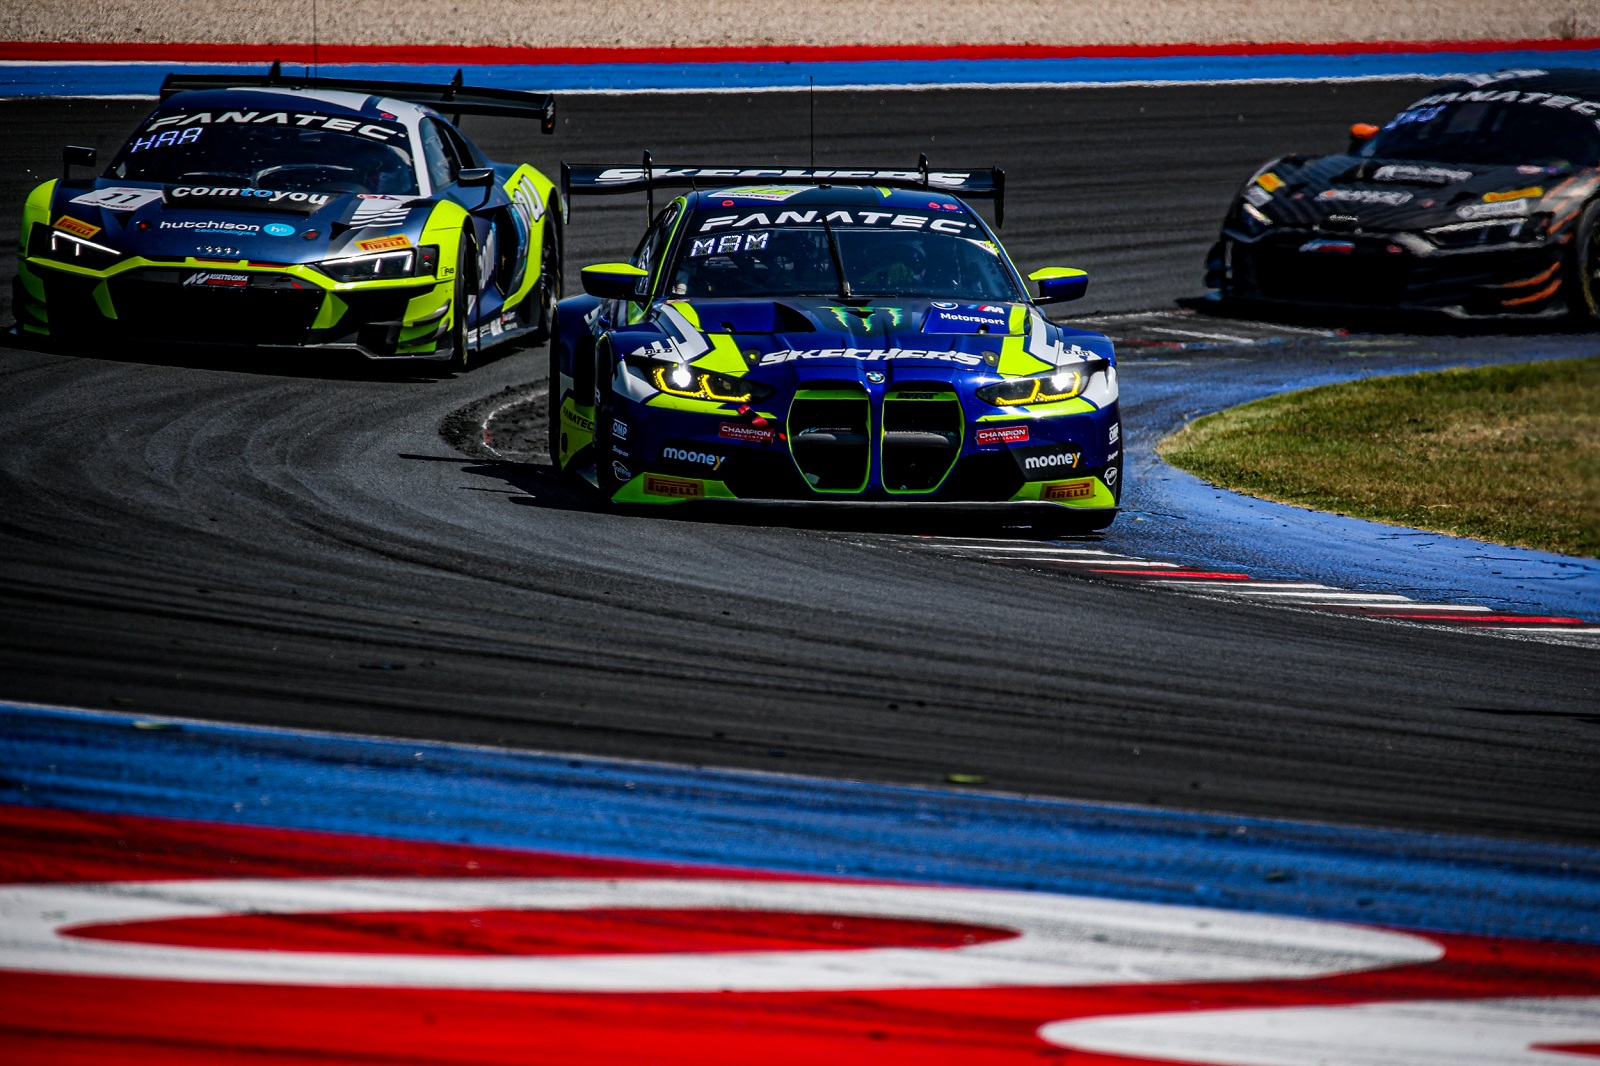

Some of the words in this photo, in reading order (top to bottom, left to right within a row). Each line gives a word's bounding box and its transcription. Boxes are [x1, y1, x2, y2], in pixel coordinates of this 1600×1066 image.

[146, 111, 397, 140] FANATEC
[131, 127, 203, 153] HAA
[100, 193, 141, 203] 11
[172, 185, 329, 205] comtoyou
[58, 218, 94, 236] PIRELLI
[160, 221, 260, 231] hutchison
[700, 211, 969, 233] FANATEC
[194, 228, 257, 236] technologies
[360, 237, 407, 251] PIRELLI
[690, 232, 769, 257] MAM
[940, 313, 1005, 325] Motorsport
[759, 348, 985, 366] SKECHERS
[721, 425, 771, 437] CHAMPION
[979, 429, 1026, 439] CHAMPION
[663, 447, 725, 471] mooney
[1025, 452, 1081, 469] mooney
[648, 478, 698, 496] PIRELLI
[1045, 483, 1090, 499] PIRELLI
